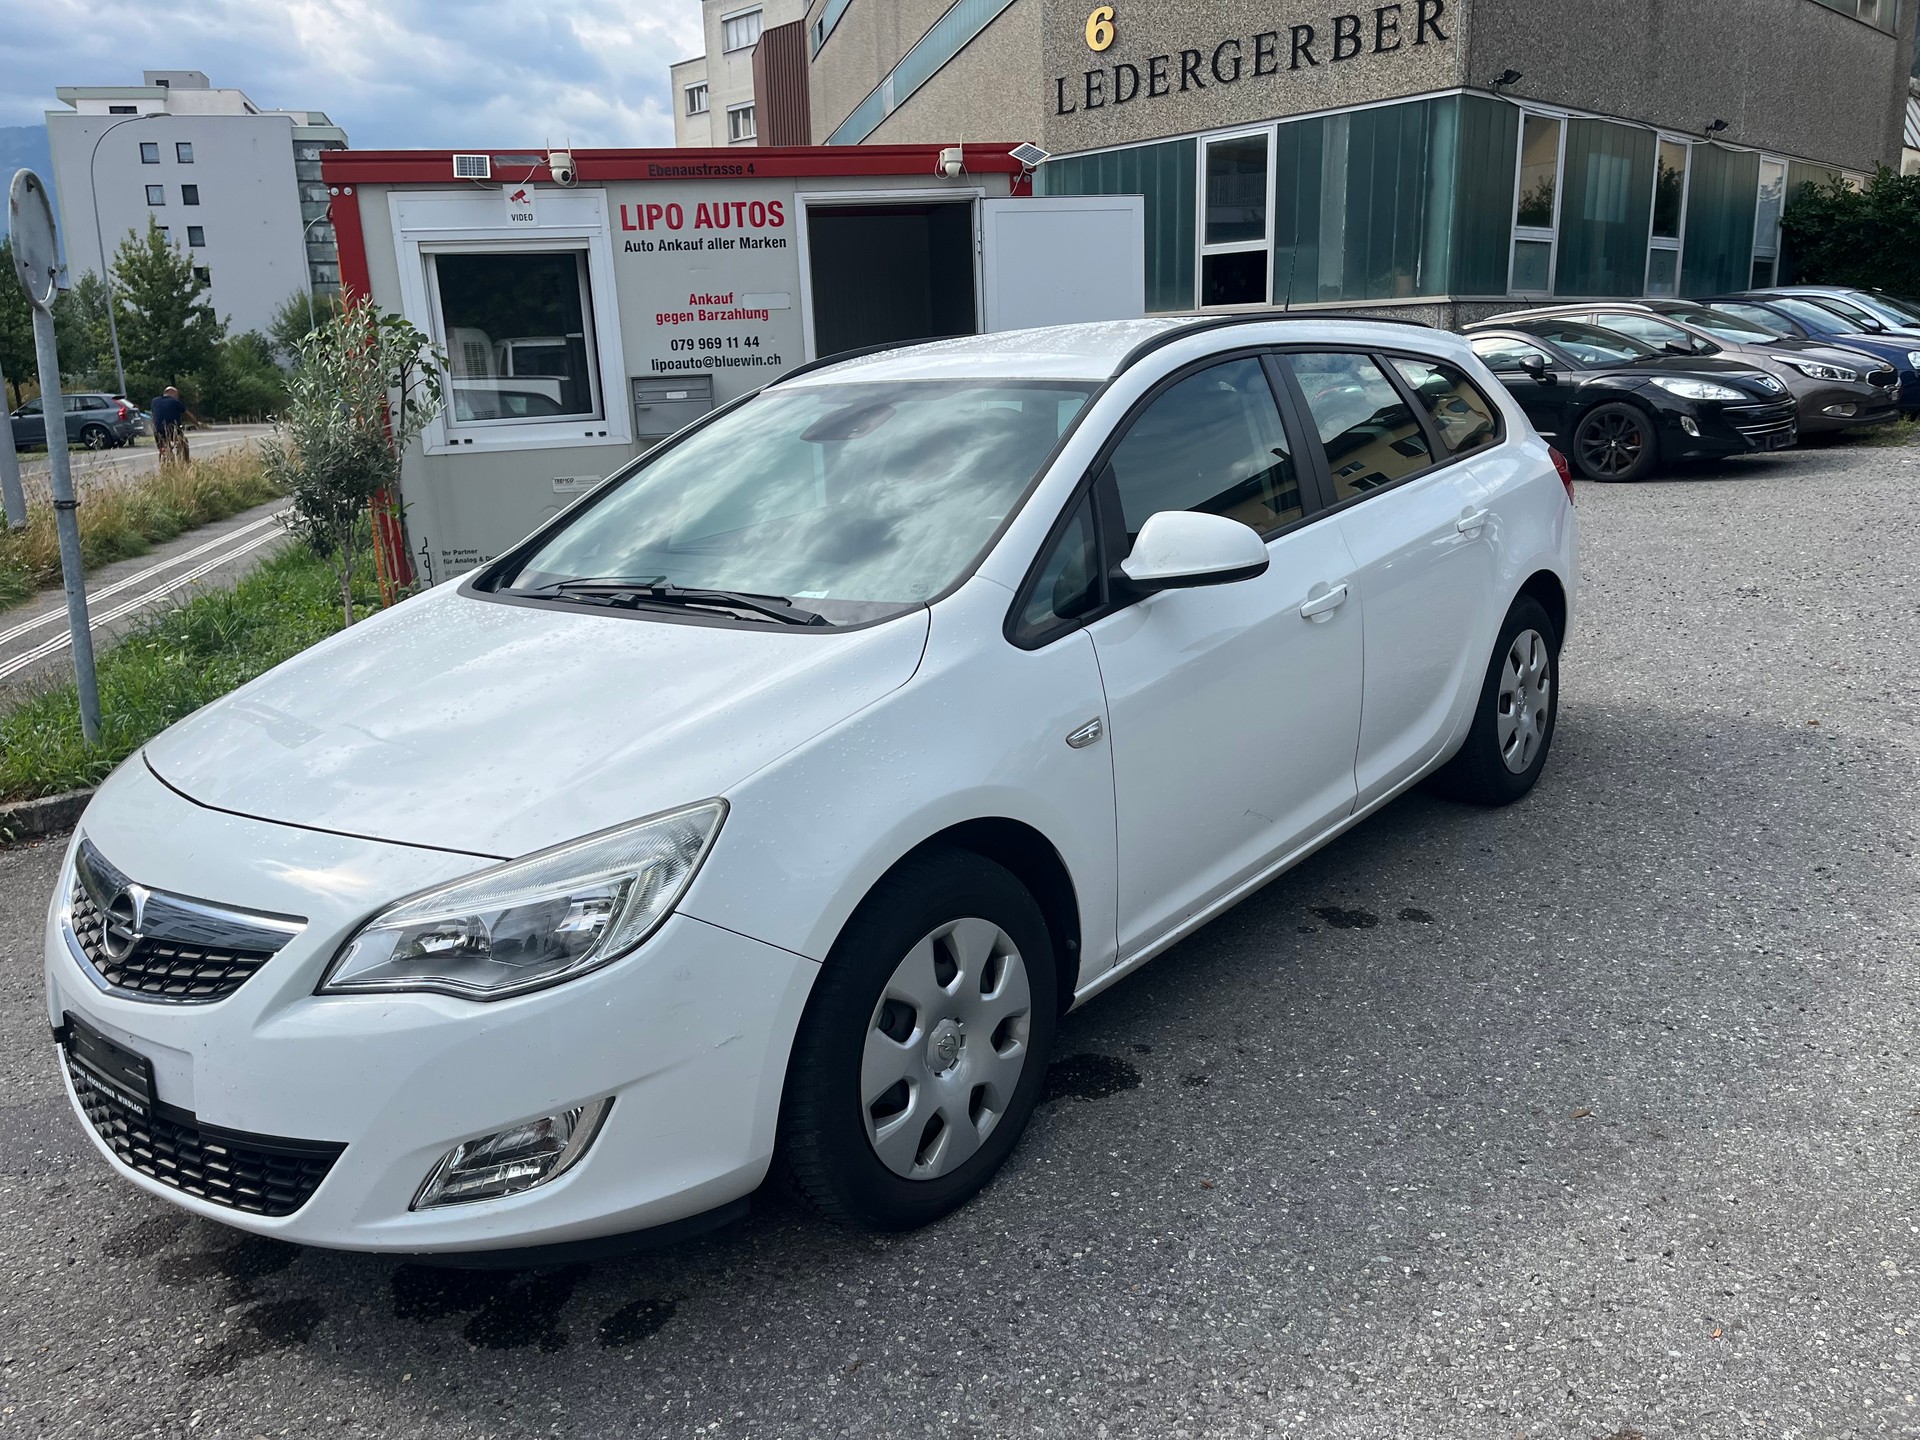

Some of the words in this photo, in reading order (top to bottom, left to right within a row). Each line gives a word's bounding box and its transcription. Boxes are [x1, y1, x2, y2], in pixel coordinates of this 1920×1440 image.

[1085, 5, 1115, 52] 6
[1055, 0, 1449, 116] LEDERGERBER
[648, 164, 743, 177] Ebenaustrasse
[747, 163, 755, 175] 4
[511, 213, 534, 222] VIDEO
[620, 203, 684, 231] LIPO
[694, 200, 785, 229] AUTOS
[624, 239, 654, 253] Auto
[658, 237, 704, 251] Ankauf
[707, 237, 735, 250] aller
[739, 236, 787, 249] Marken
[689, 292, 734, 306] Ankauf
[656, 311, 694, 325] gegen
[698, 308, 769, 322] Barzahlung
[670, 338, 695, 351] 079
[698, 337, 722, 349] 969
[726, 336, 739, 348] 11
[744, 336, 760, 348] 44
[651, 353, 782, 373] lipoauto@bluewin.ch
